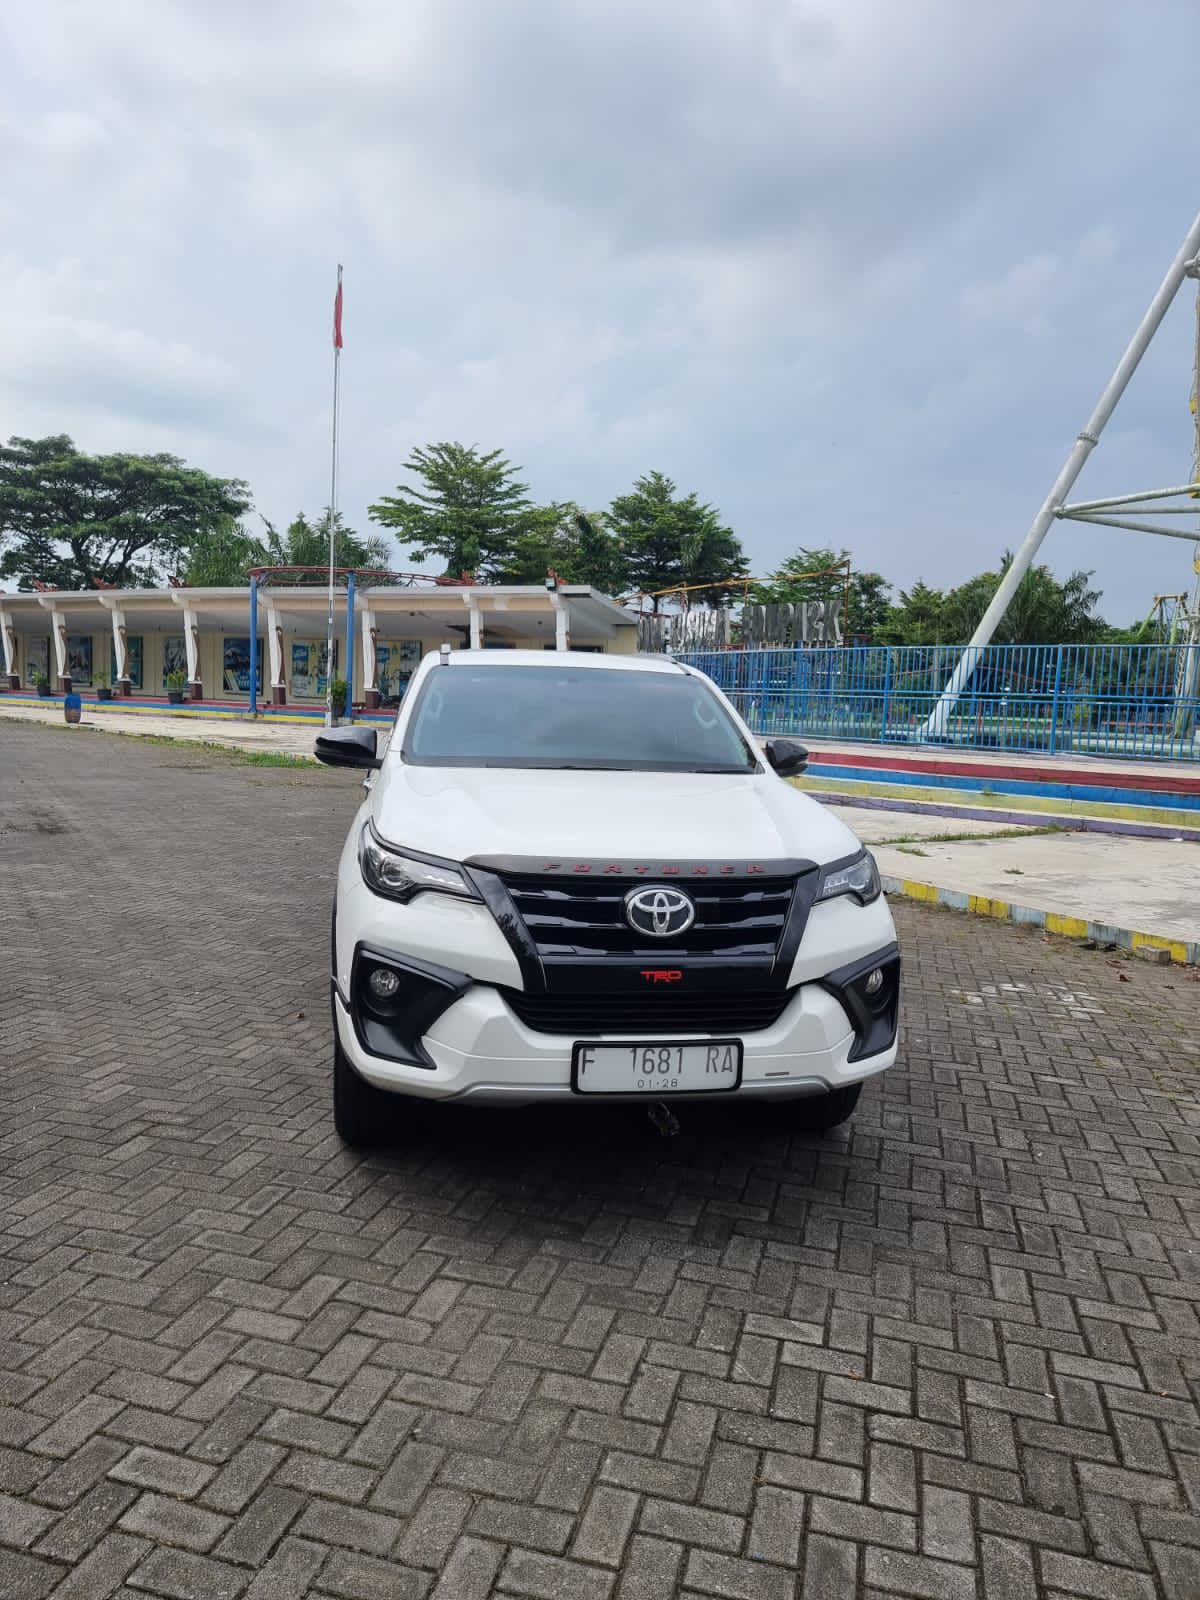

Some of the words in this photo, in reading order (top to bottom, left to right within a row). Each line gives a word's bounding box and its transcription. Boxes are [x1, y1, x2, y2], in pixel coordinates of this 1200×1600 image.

[543, 863, 765, 875] FORTUNER
[640, 970, 682, 983] TRD
[581, 1048, 596, 1075] F
[630, 1047, 684, 1074] 1681
[705, 1046, 734, 1073] RA
